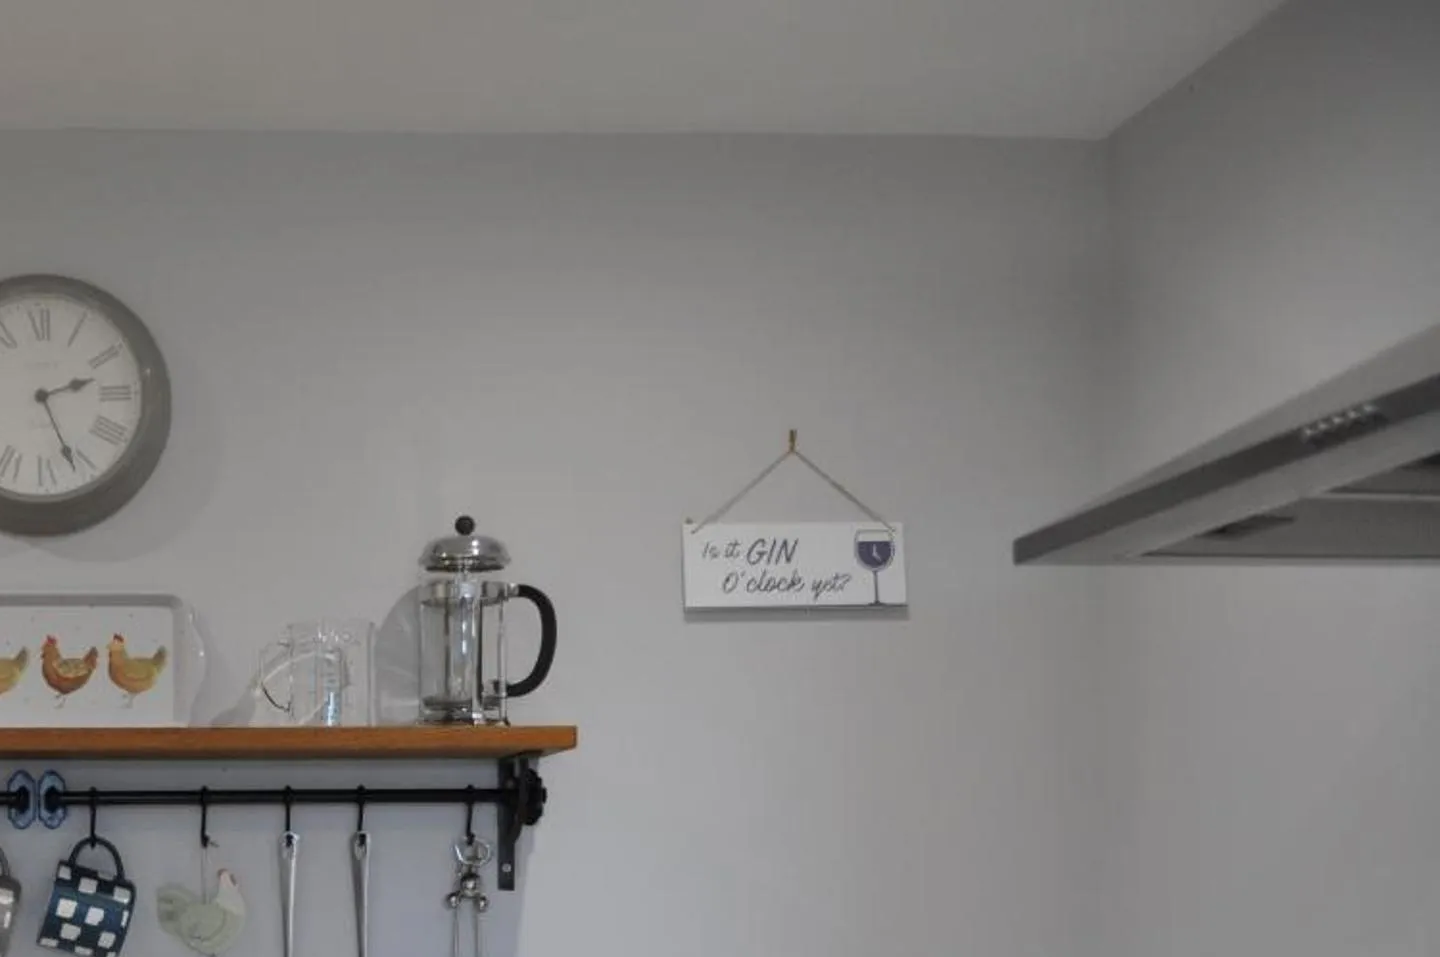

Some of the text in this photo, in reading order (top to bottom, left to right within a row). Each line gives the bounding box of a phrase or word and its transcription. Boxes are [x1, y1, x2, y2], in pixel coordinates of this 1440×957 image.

[87, 343, 120, 370] II
[99, 384, 132, 402] III
[724, 539, 741, 559] it
[746, 537, 799, 565] GIN
[722, 568, 852, 601] O'clock yet?
